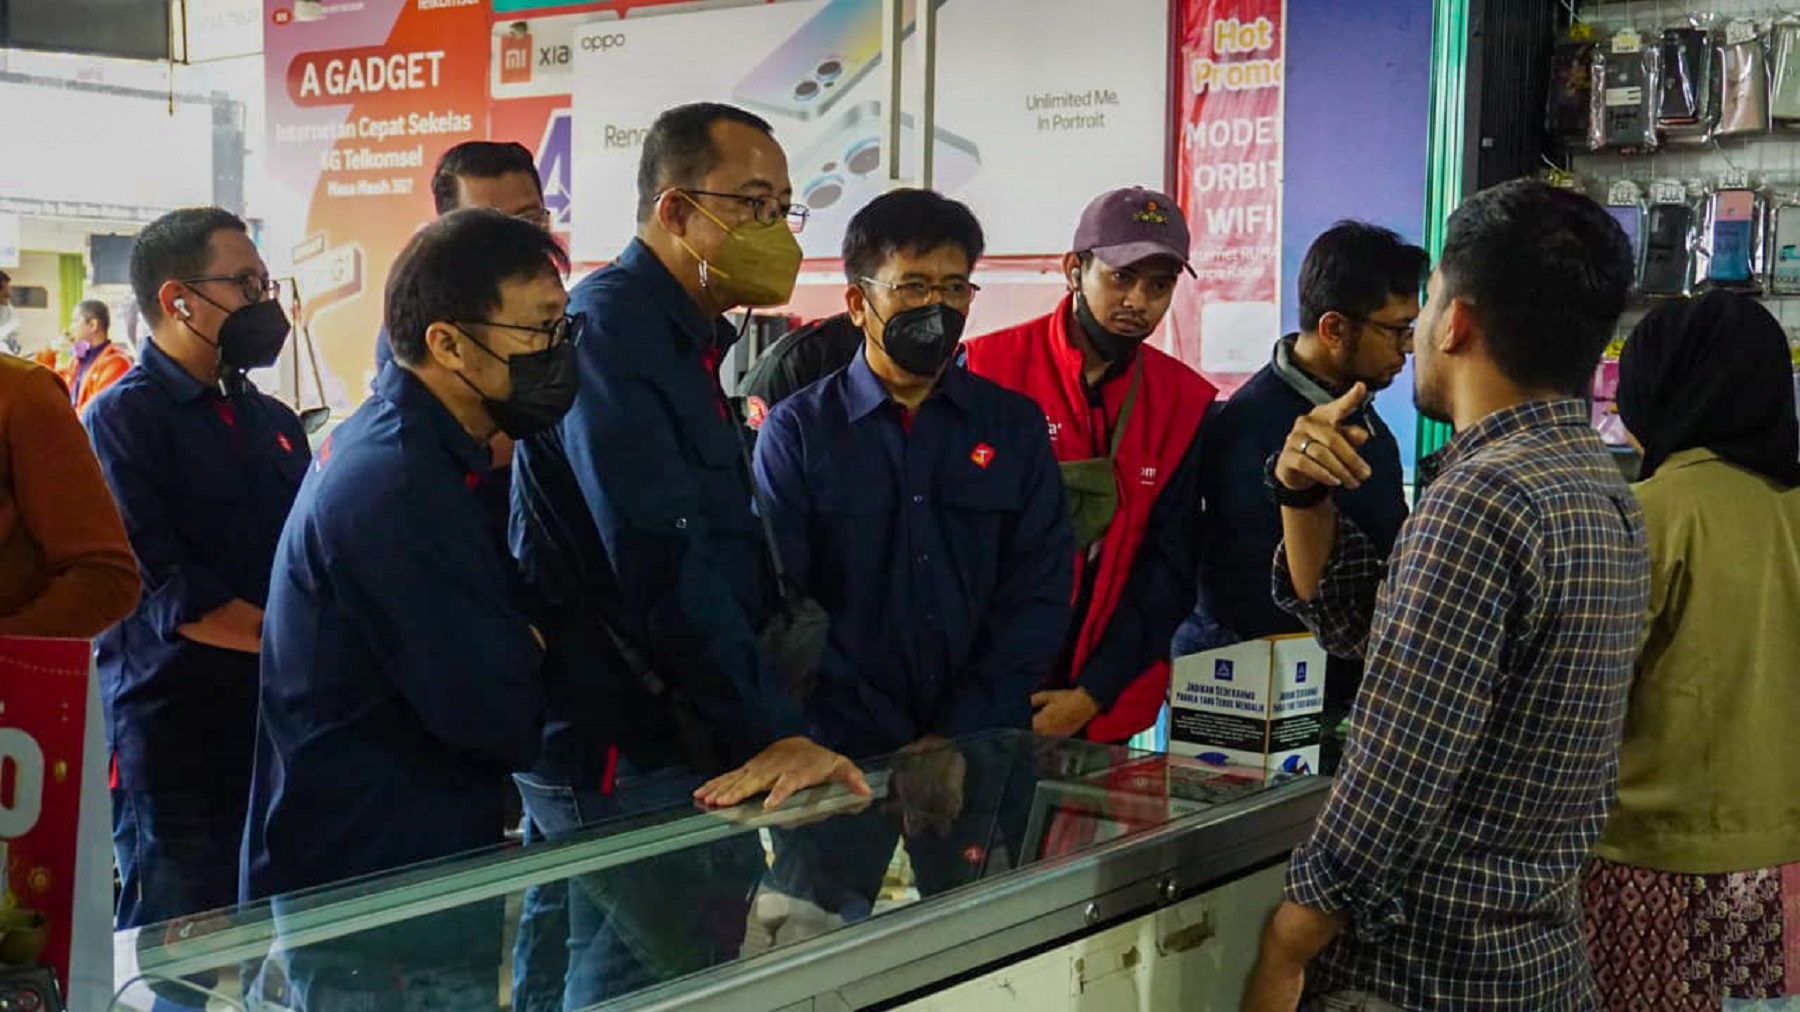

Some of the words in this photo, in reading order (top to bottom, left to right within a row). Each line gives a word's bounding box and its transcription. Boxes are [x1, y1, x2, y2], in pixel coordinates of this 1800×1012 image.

[1215, 18, 1272, 52] Hot
[539, 44, 573, 66] xia
[301, 61, 322, 98] A
[325, 50, 446, 96] GADGET
[1025, 91, 1093, 111] Unlimited
[275, 120, 356, 142] Internetan
[358, 116, 404, 142] Cepat
[407, 110, 473, 135] Sekelas
[1052, 112, 1104, 131] Portrait
[344, 145, 424, 170] Telkomsel
[1205, 204, 1274, 235] WIFI
